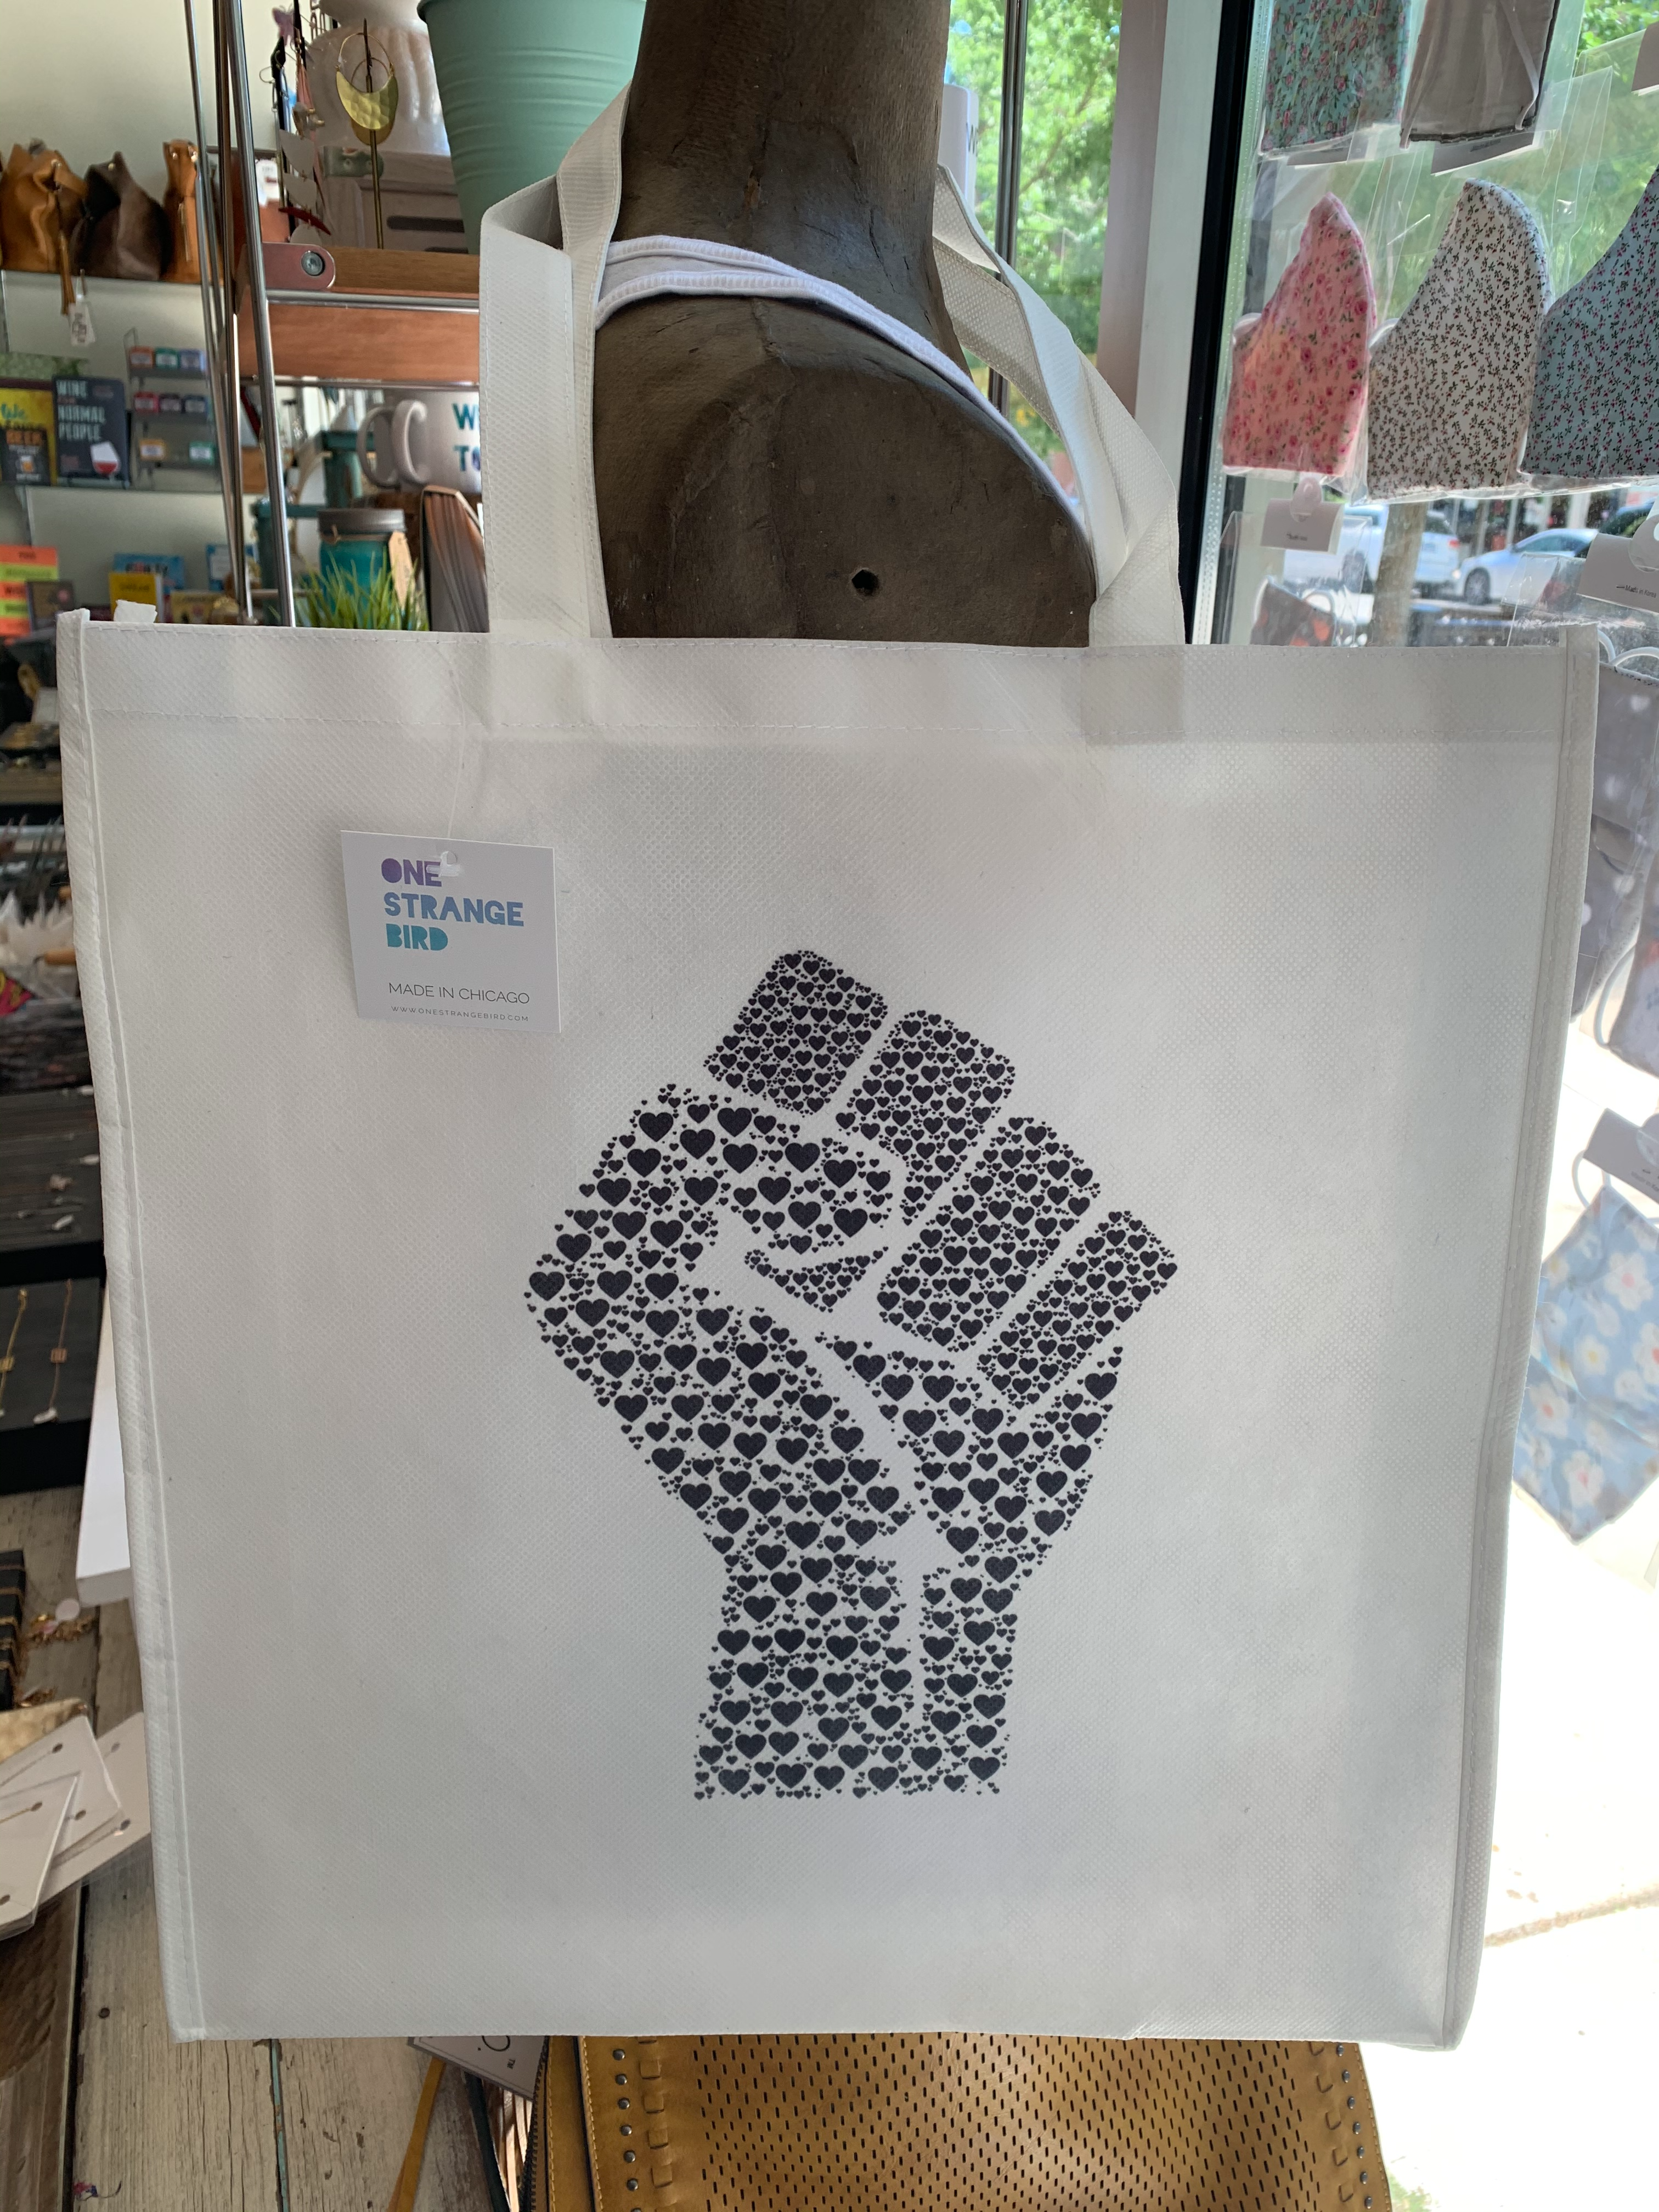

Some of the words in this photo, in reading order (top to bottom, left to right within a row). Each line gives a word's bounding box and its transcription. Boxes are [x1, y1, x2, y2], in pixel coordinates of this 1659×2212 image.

[58, 405, 105, 424] NORMAL
[59, 422, 101, 442] PEOPLE
[381, 858, 442, 887] ONE
[384, 892, 524, 927] STRANGE
[386, 923, 448, 951] BIRD
[389, 982, 435, 997] MADE
[438, 986, 454, 998] IN
[459, 988, 530, 1004] CHICAGO
[391, 1006, 528, 1022] WWW.ONESTRANGEBIRD.COM
